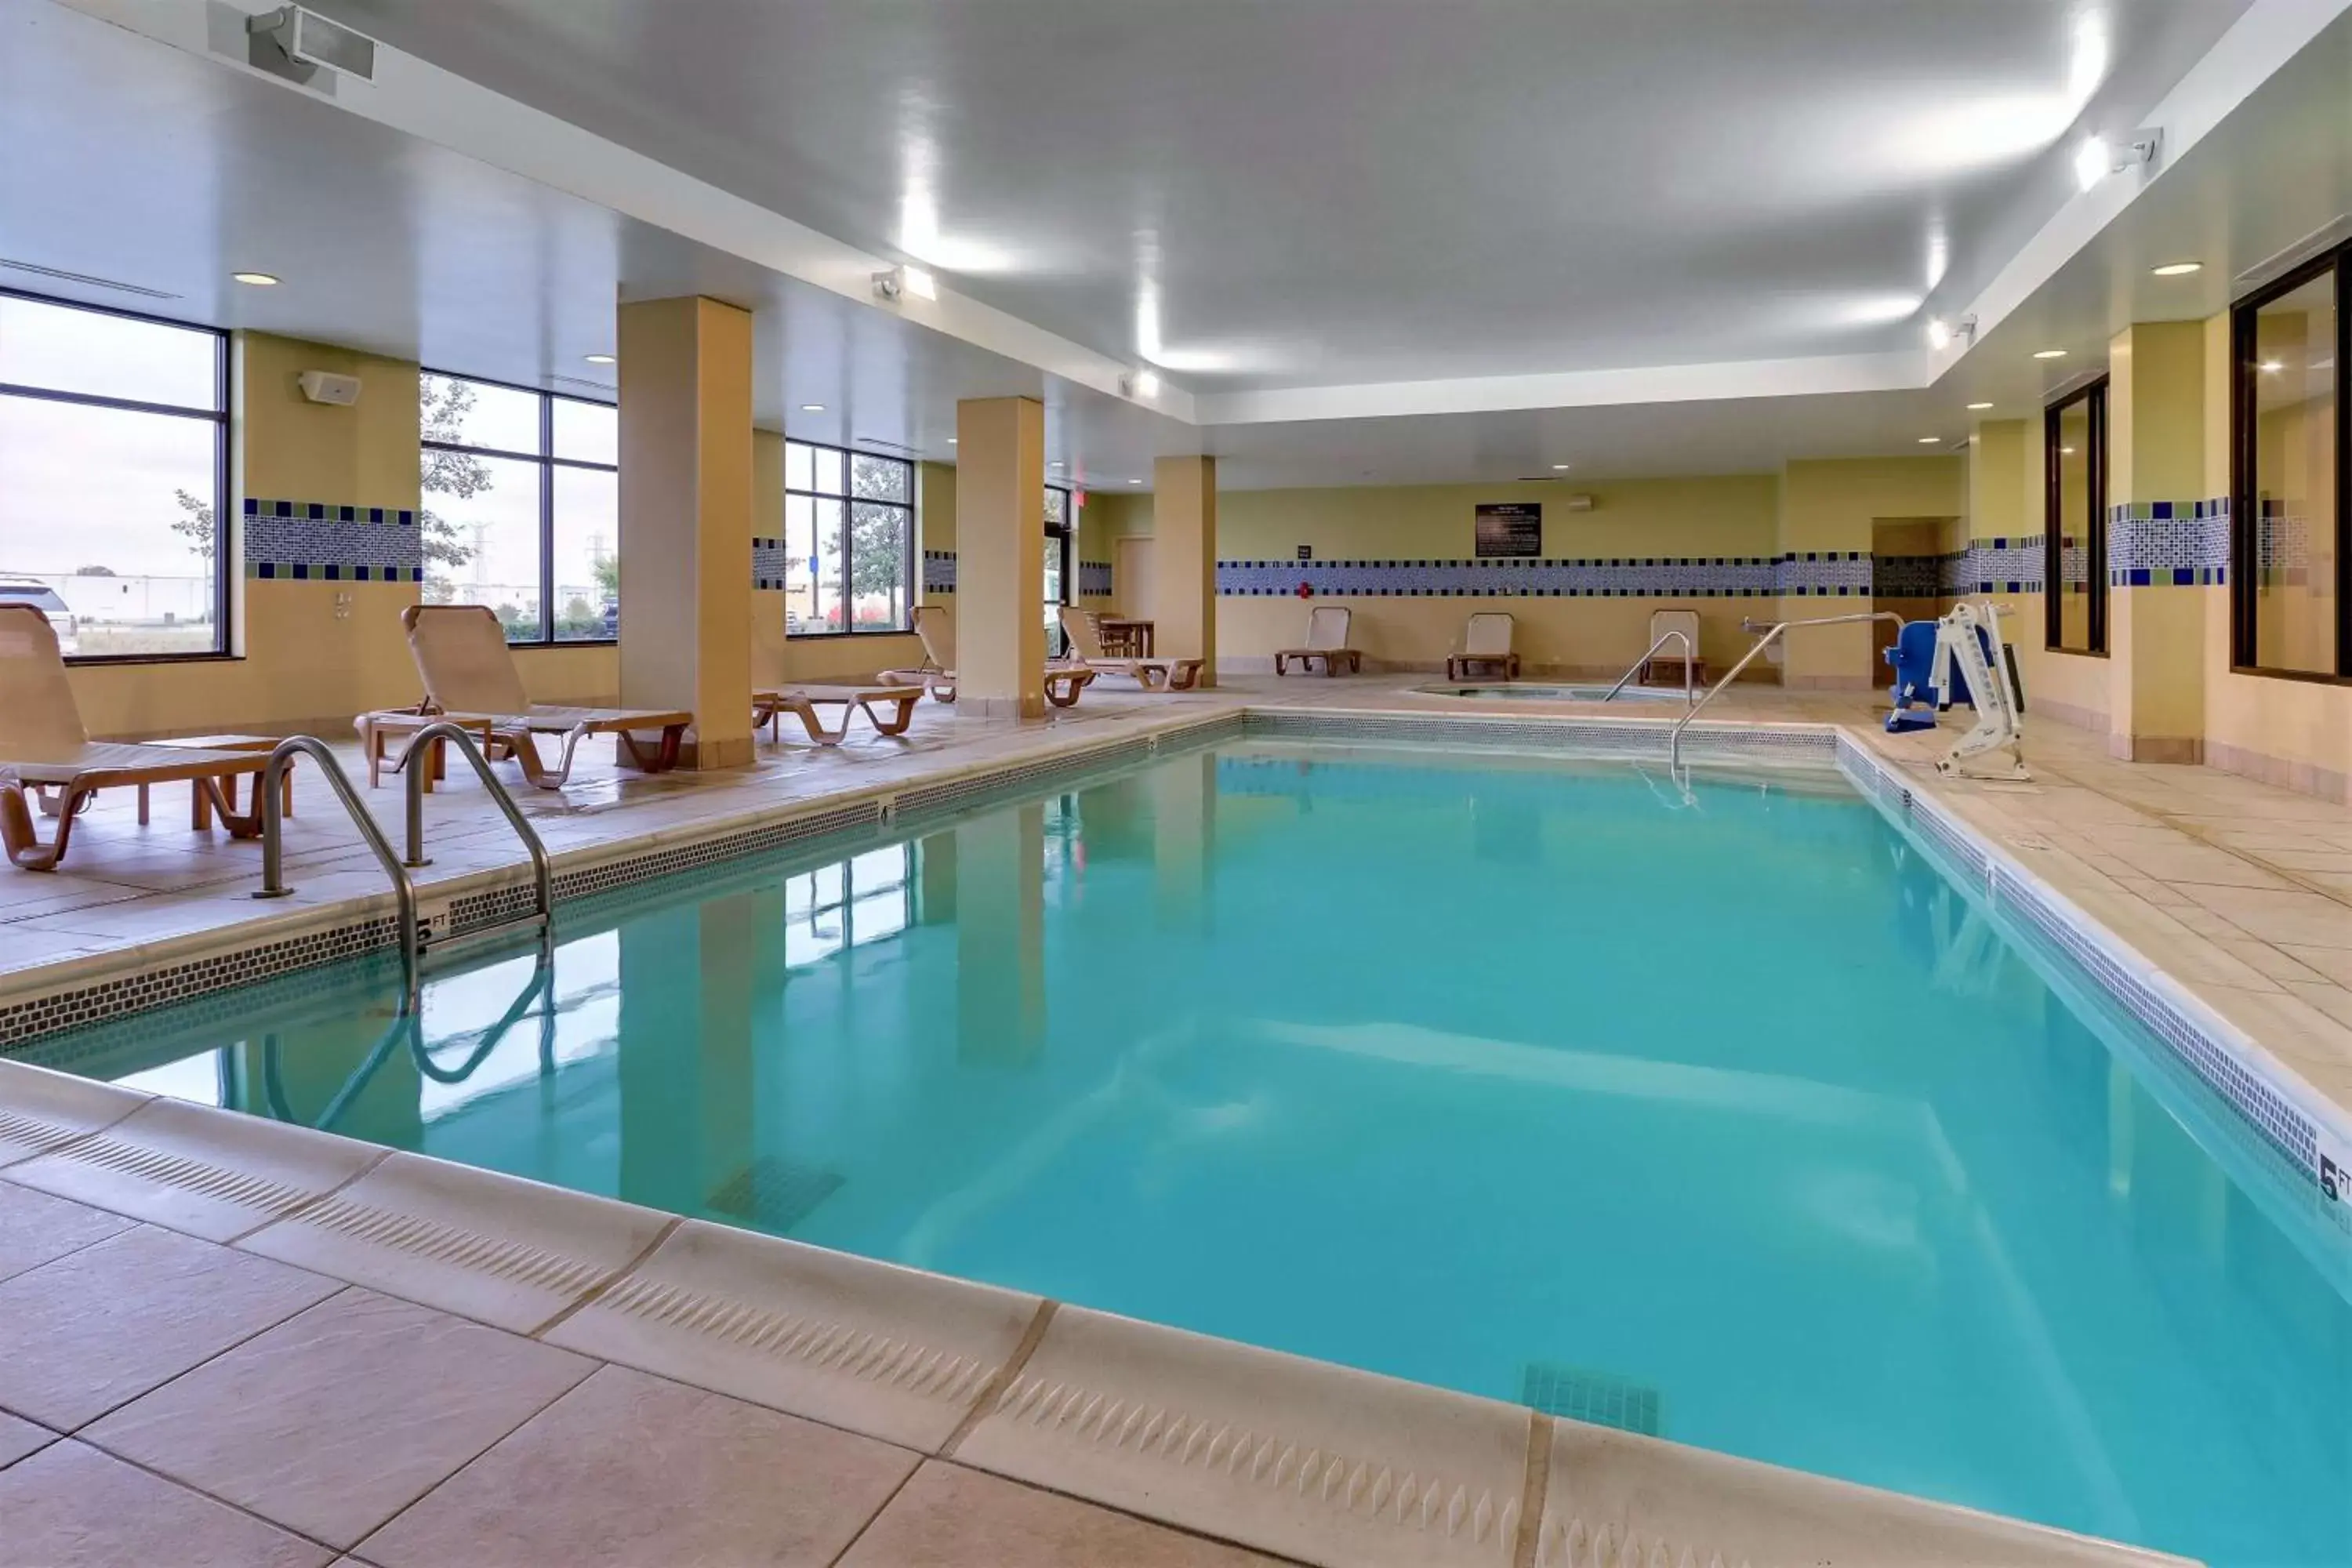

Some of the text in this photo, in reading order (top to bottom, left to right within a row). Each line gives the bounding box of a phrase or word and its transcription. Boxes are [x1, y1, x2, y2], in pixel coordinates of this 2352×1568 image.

[433, 913, 446, 928] FT
[2320, 1153, 2351, 1201] 5 FT
